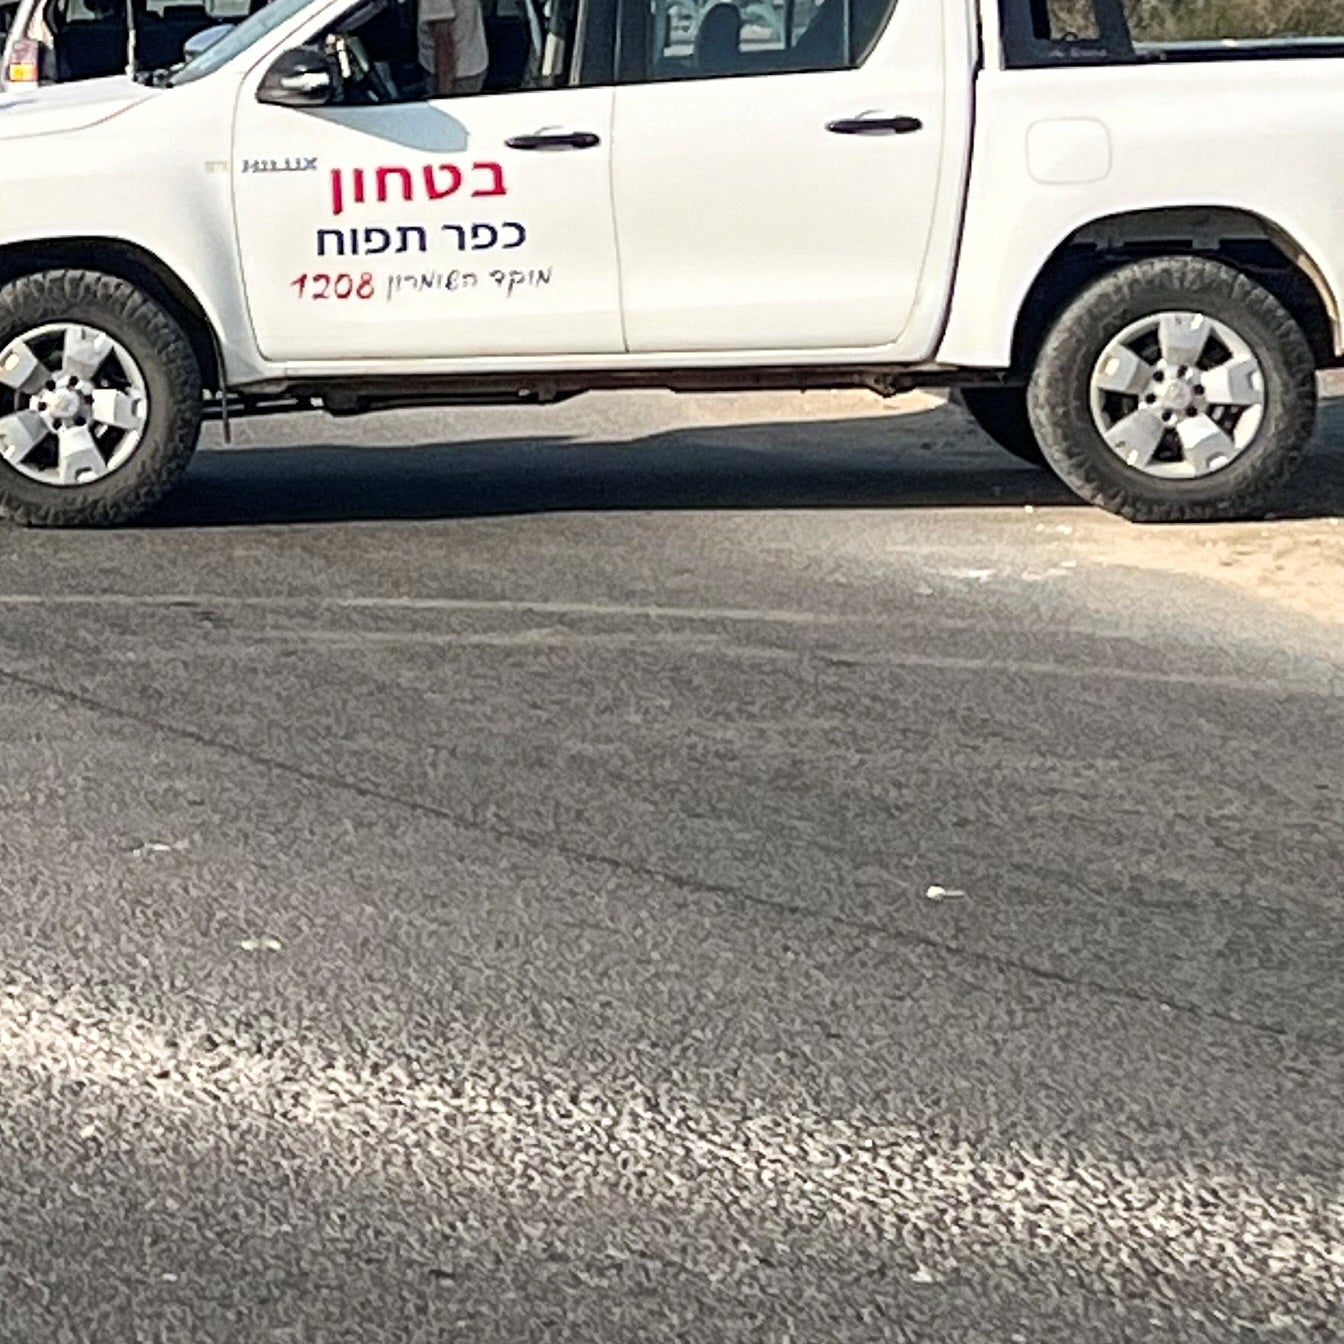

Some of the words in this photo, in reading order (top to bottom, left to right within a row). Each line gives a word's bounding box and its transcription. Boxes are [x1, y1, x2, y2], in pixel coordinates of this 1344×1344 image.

[331, 162, 506, 216] בטחון
[317, 227, 426, 256] תפוח
[442, 222, 525, 251] כפר
[292, 272, 374, 300] 1208
[386, 269, 478, 301] השומרון
[489, 267, 552, 297] מוקד
